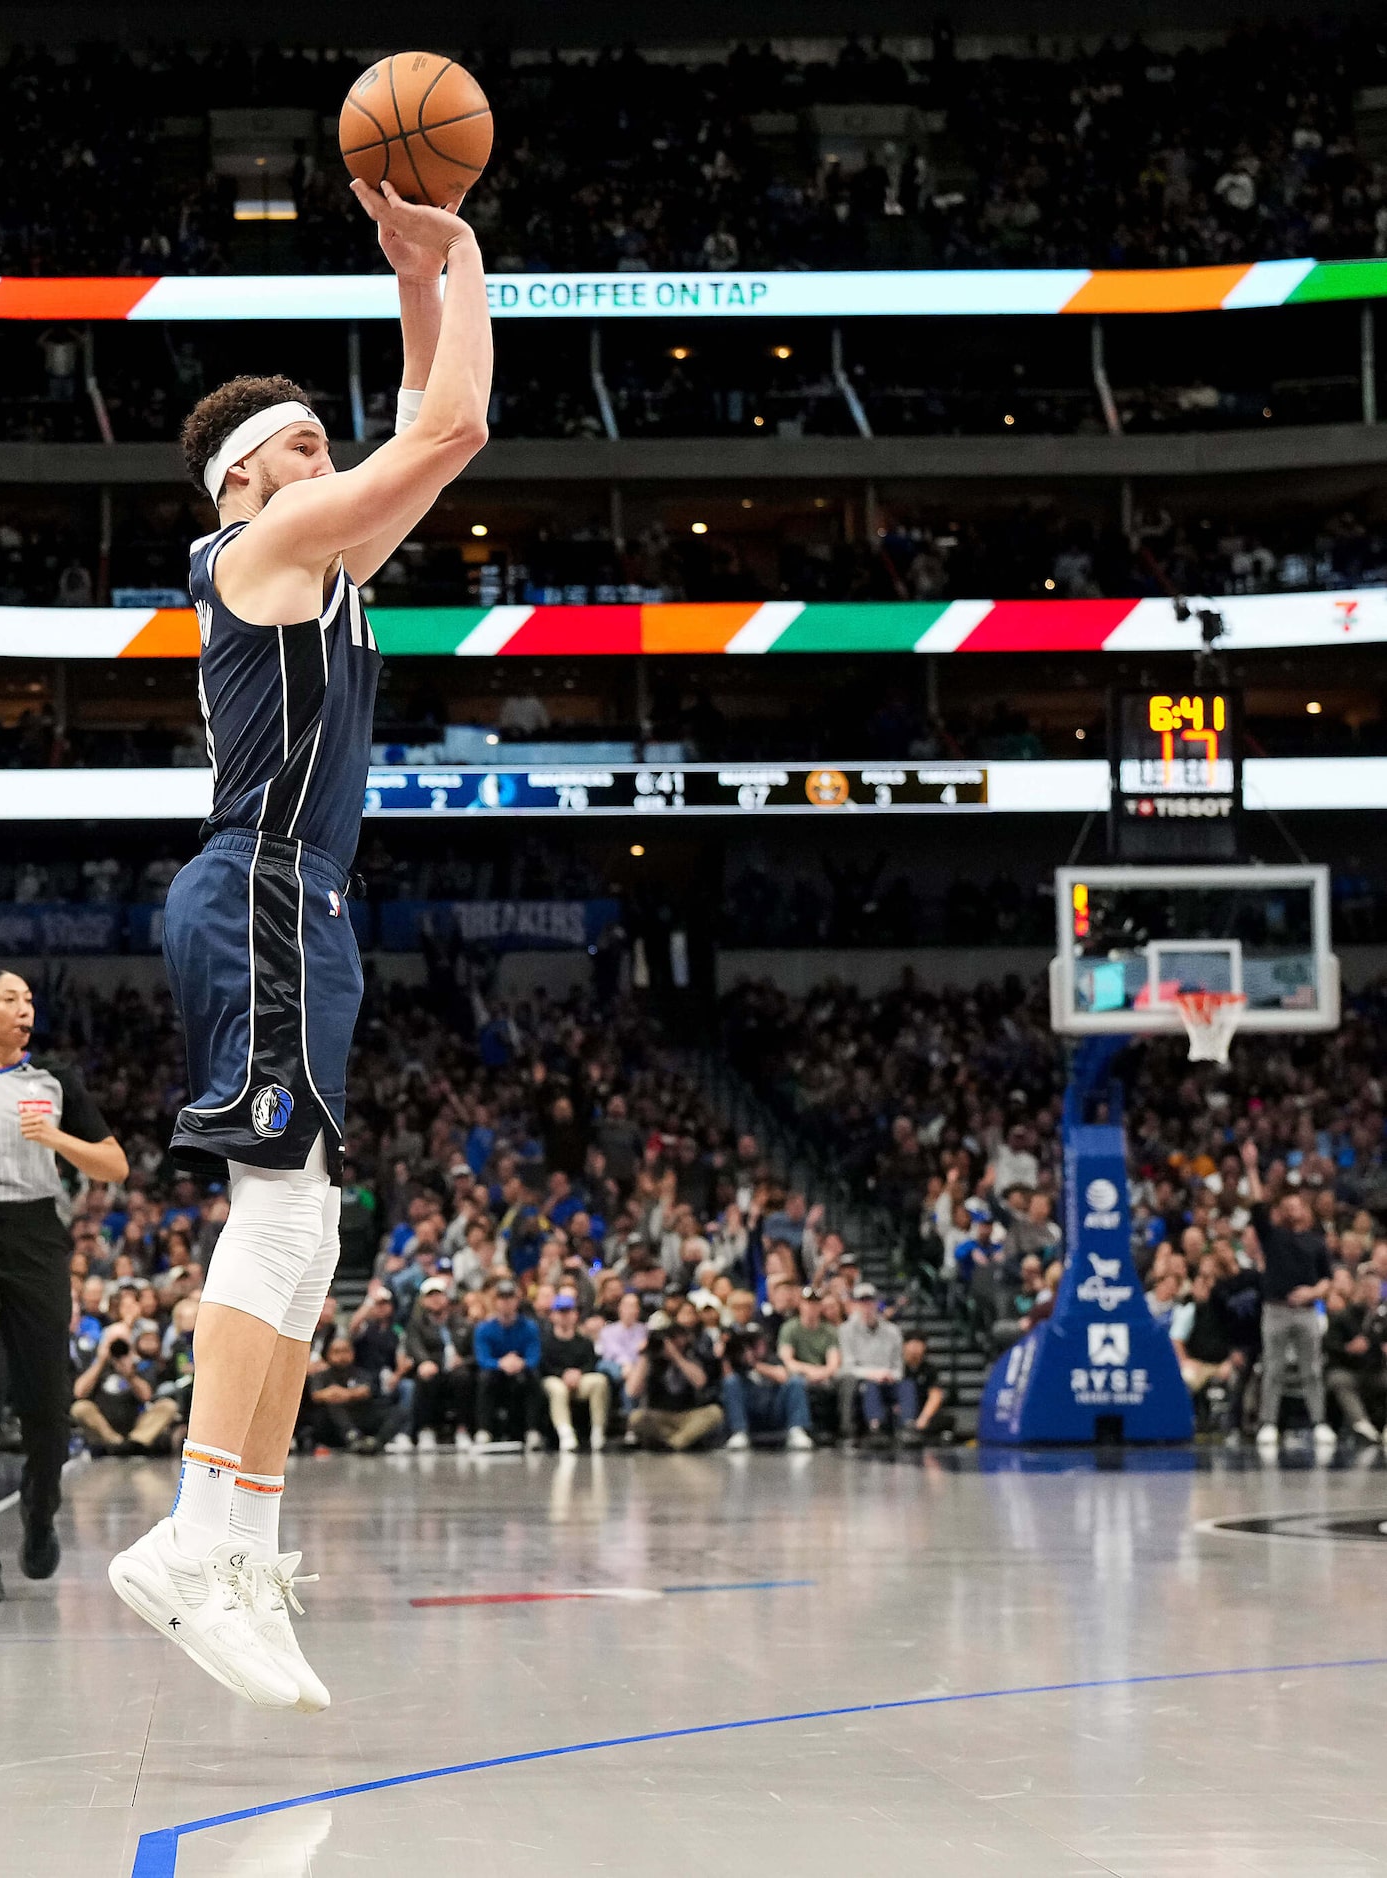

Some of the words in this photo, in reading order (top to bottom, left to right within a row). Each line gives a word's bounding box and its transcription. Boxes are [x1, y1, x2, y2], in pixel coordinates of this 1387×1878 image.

[485, 284, 519, 307] ED
[528, 283, 647, 308] COFFEE
[656, 282, 700, 307] ON
[710, 281, 768, 306] TAP
[1149, 695, 1225, 731] 6:41
[634, 771, 685, 795] 6:41
